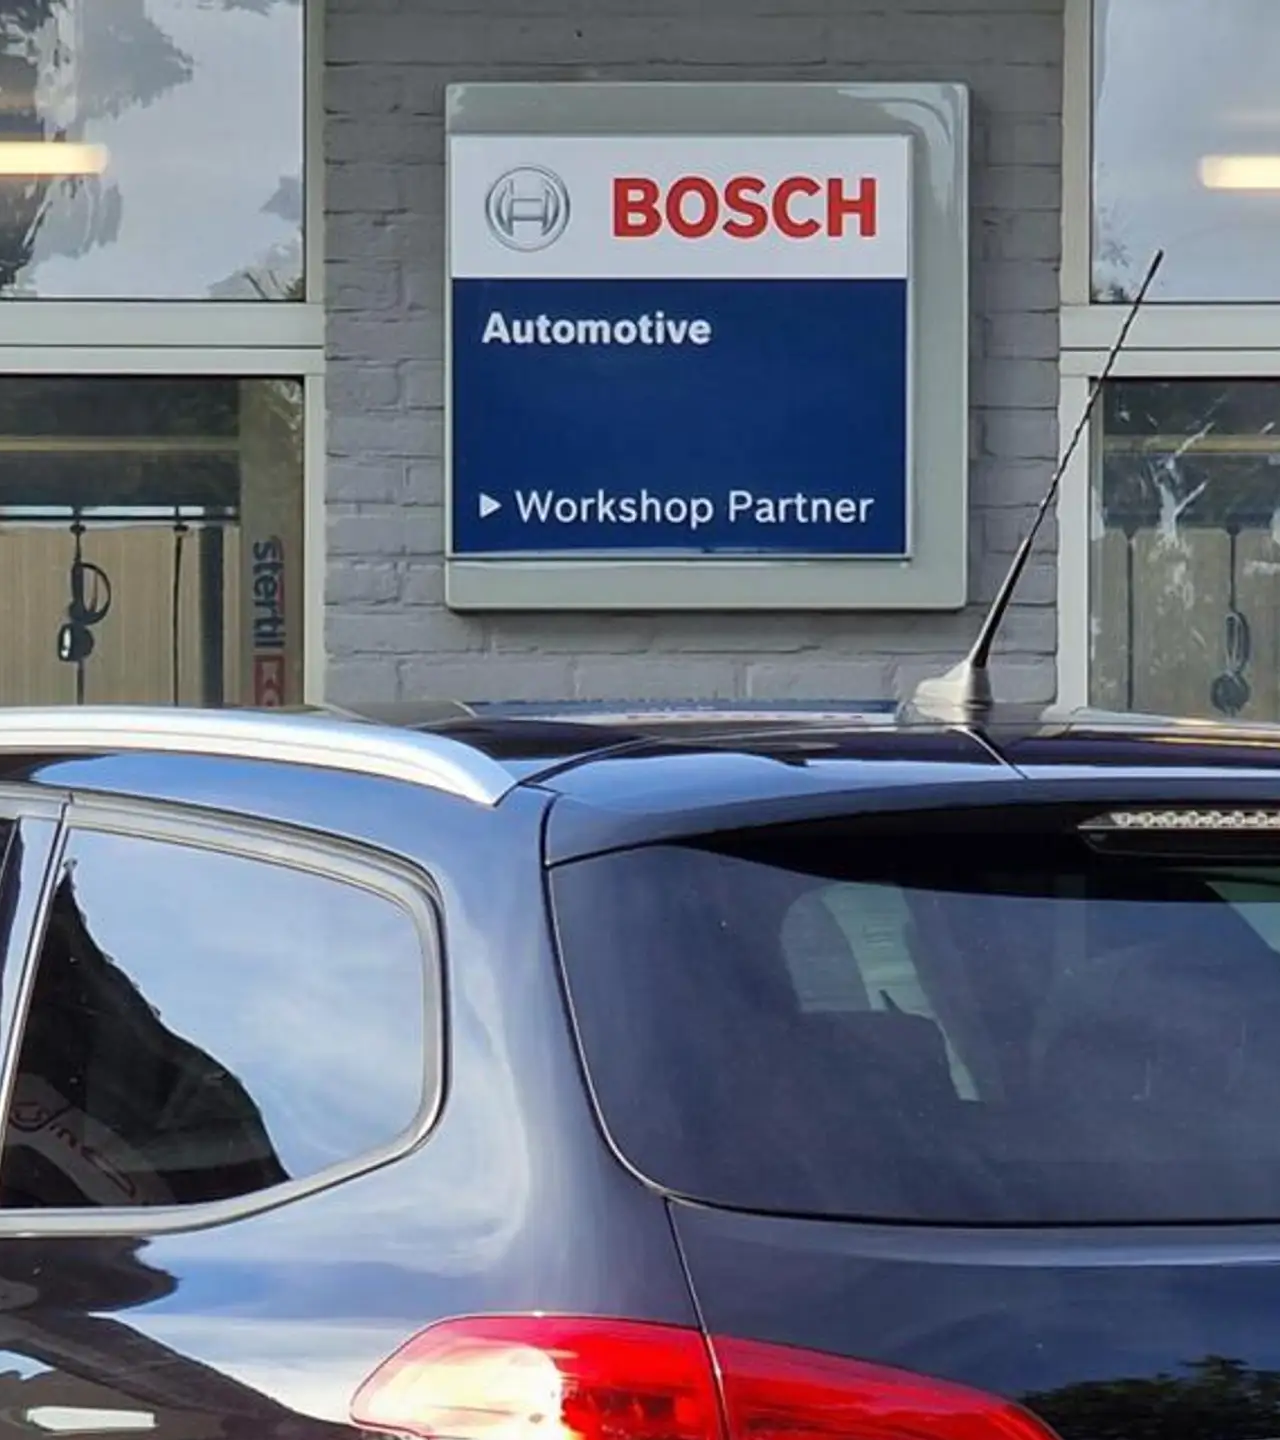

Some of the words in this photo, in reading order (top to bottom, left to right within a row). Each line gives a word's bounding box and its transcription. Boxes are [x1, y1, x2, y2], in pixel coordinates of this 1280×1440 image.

[612, 176, 876, 239] BOSCH
[481, 311, 712, 345] Automotive
[514, 489, 714, 529] Workshop
[727, 489, 875, 523] Partner
[253, 541, 286, 648] stertil
